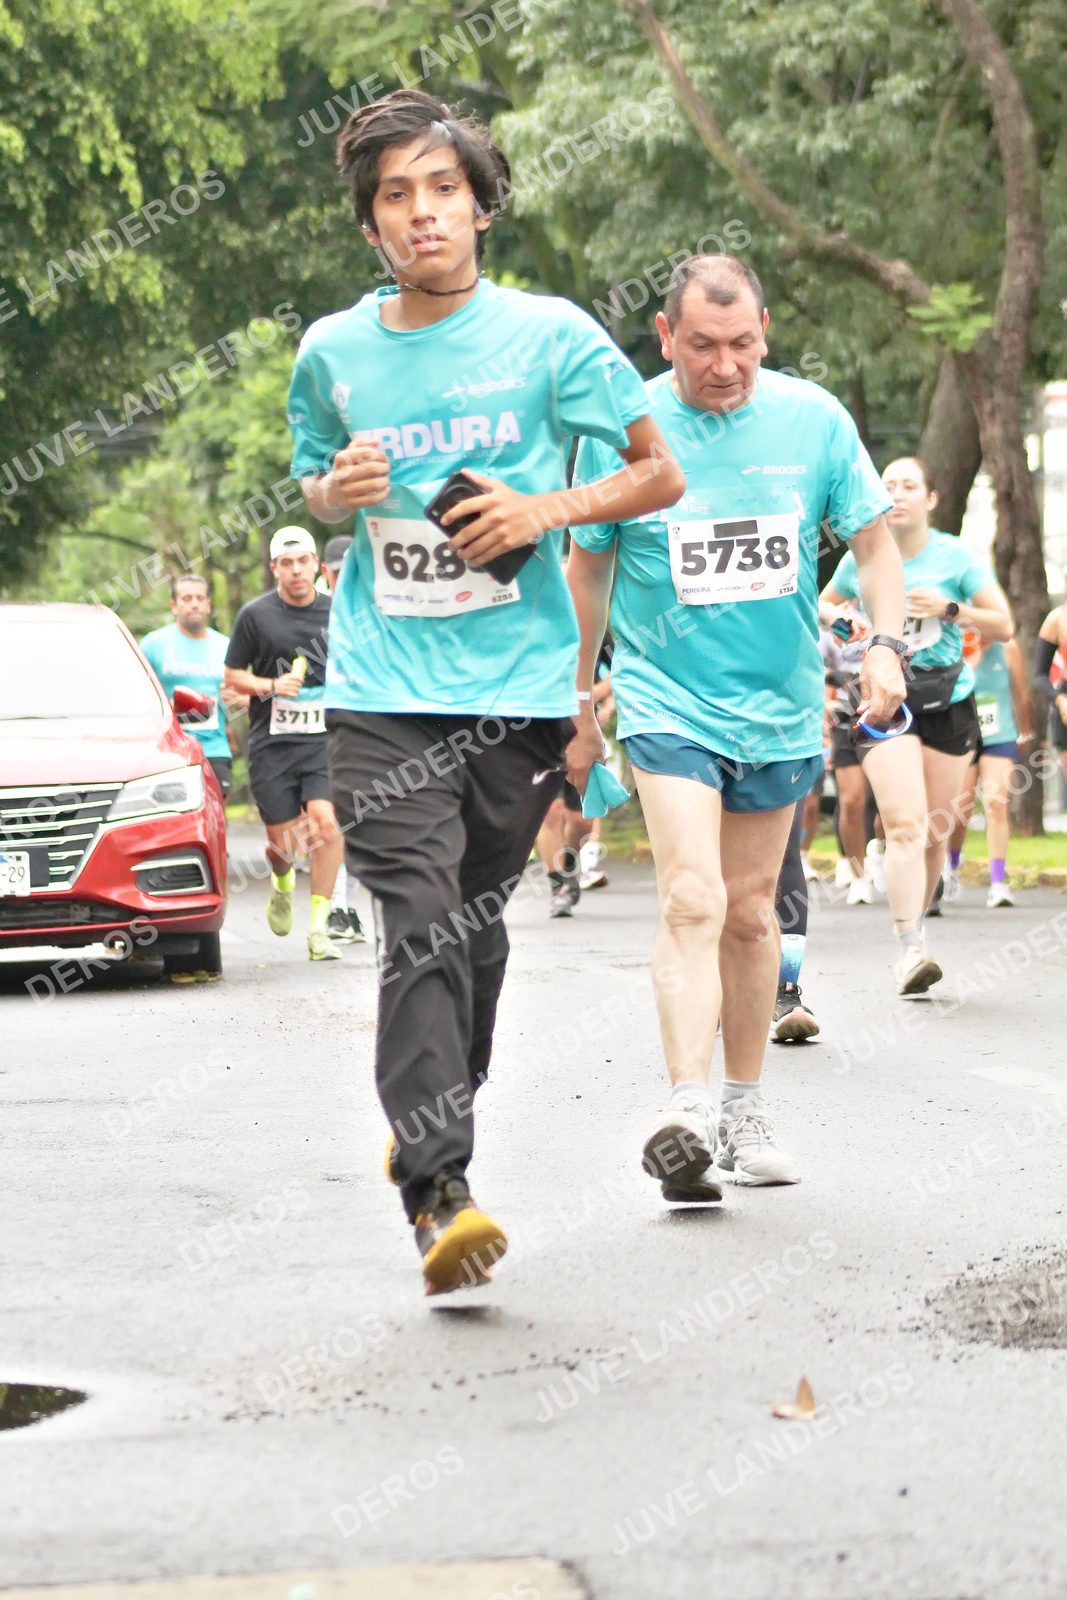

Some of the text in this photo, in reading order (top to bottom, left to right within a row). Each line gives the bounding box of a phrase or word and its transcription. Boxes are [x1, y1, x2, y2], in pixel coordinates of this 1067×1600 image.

[762, 465, 808, 475] BROOKS
[383, 541, 487, 583] 628
[680, 535, 791, 576] 5738
[276, 708, 321, 724] 3711
